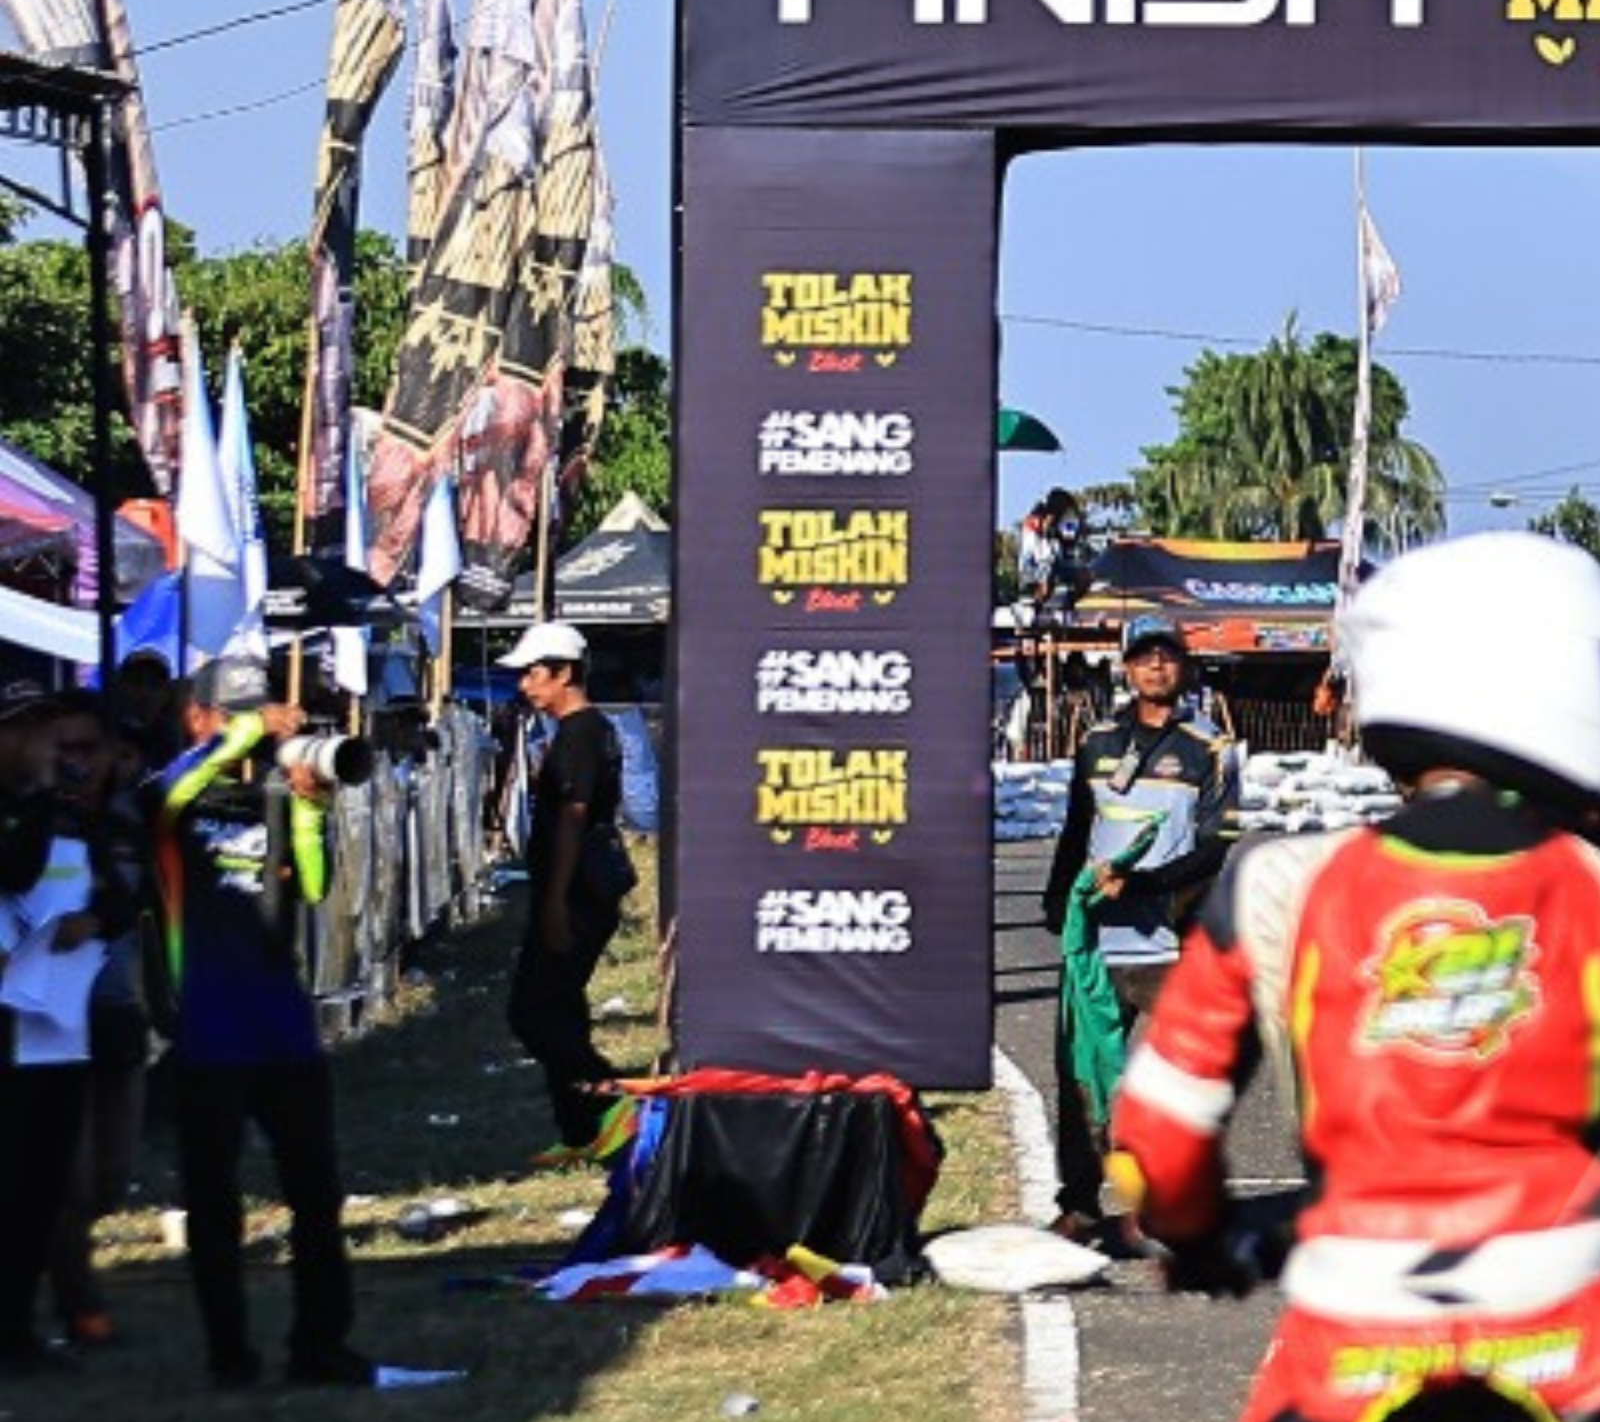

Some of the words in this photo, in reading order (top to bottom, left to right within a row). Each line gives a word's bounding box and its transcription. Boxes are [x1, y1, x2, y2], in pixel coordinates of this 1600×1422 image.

[761, 273, 912, 308] TOLAK
[761, 302, 912, 345] MISKIN
[758, 411, 914, 448] #SANG
[757, 510, 908, 546] TOLAK
[757, 539, 908, 585] MISKIN
[756, 651, 912, 688] #SANG
[756, 749, 909, 786] TOLAK
[756, 779, 908, 824] MISKIN
[756, 890, 912, 926] #SANG
